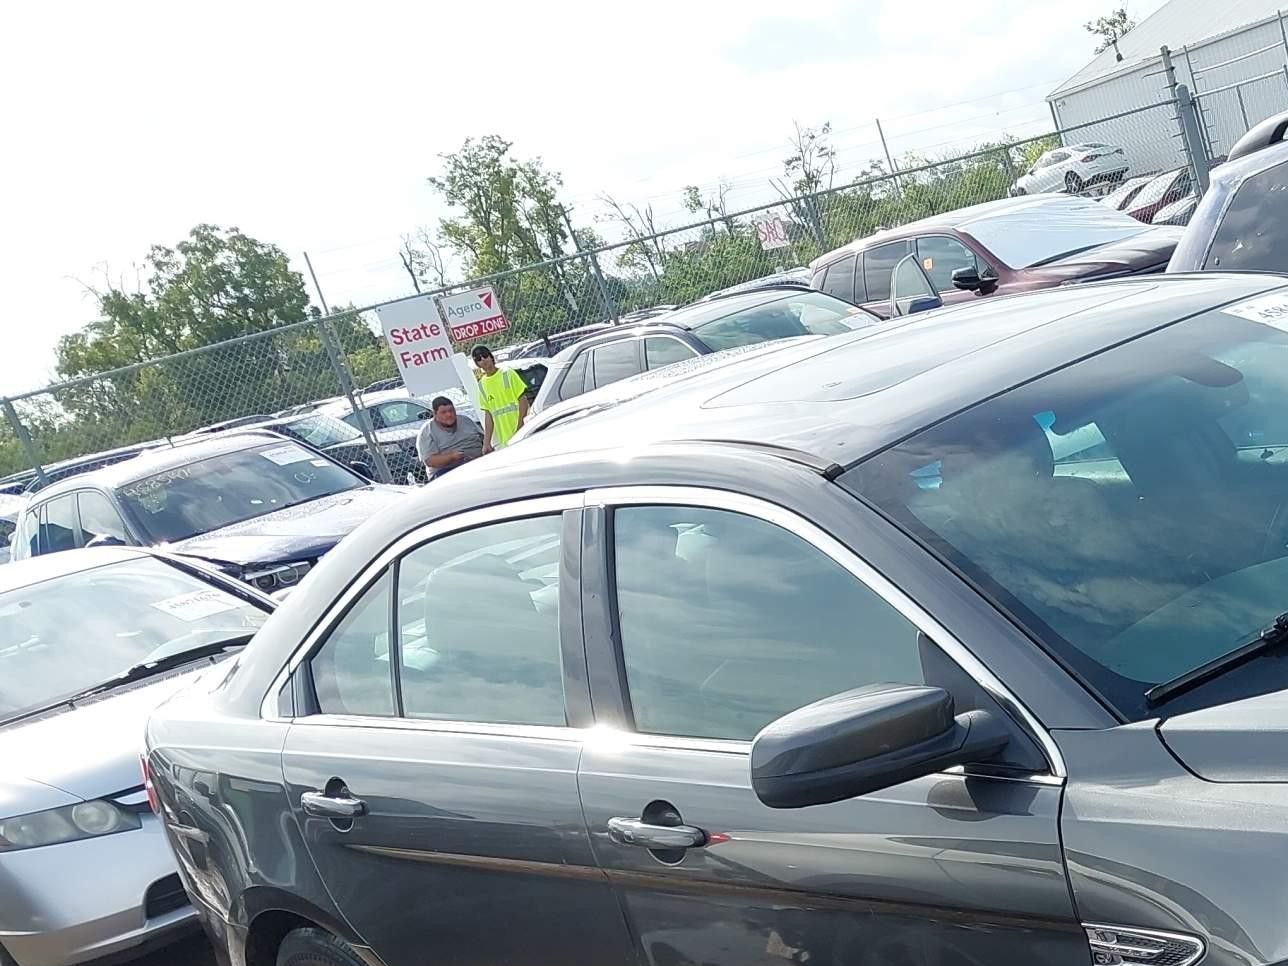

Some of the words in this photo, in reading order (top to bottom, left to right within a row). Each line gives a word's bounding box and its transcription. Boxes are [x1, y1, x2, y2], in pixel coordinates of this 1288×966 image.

[448, 300, 482, 318] Agero
[390, 322, 441, 345] State
[453, 324, 479, 341] DROP
[479, 317, 506, 335] ZONE
[400, 345, 449, 369] Farm
